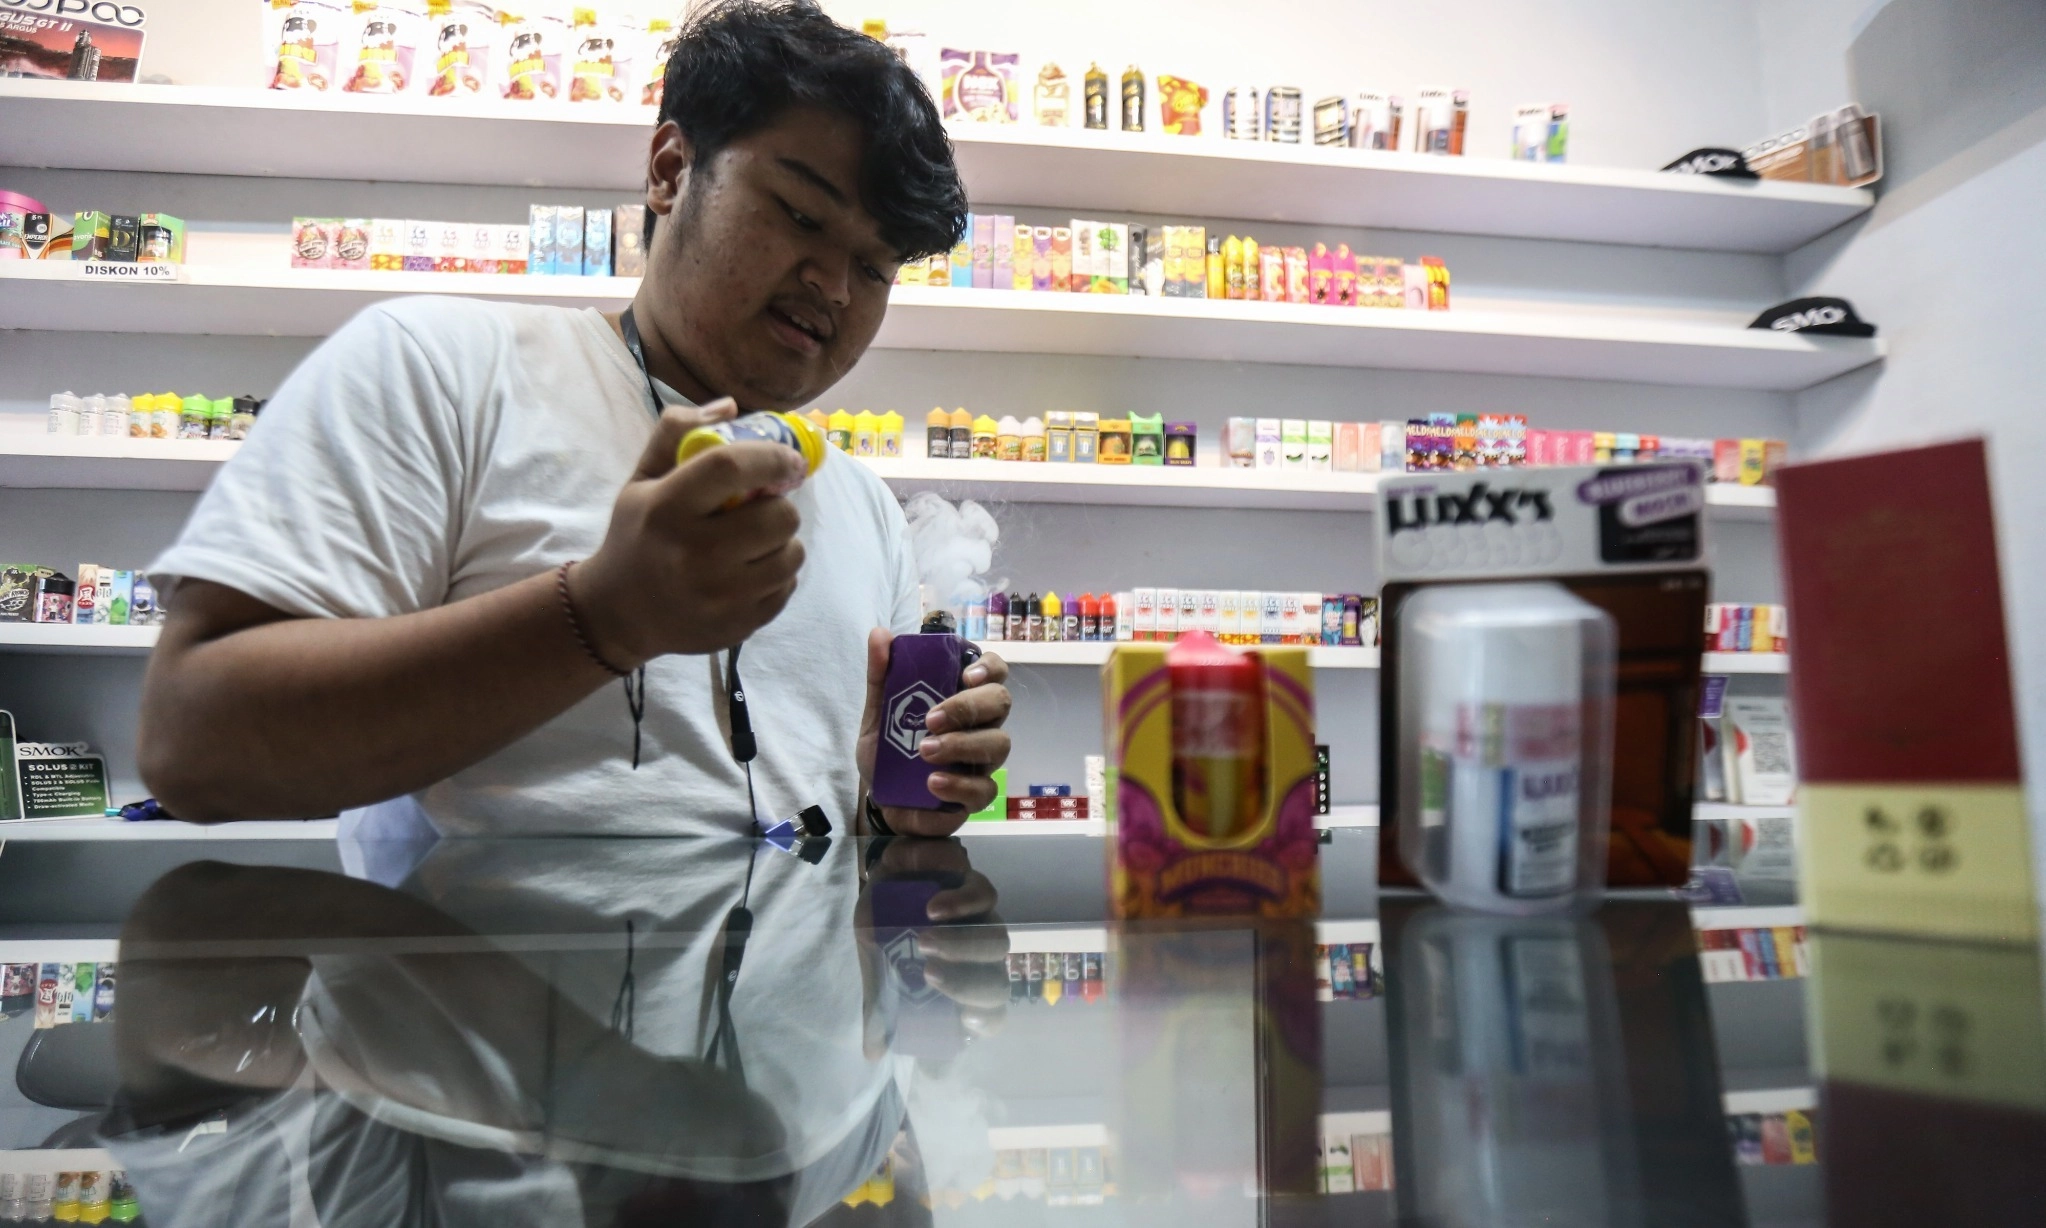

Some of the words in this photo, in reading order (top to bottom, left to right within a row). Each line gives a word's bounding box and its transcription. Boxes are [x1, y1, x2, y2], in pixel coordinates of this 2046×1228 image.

[85, 265, 139, 276] DISKON
[143, 265, 170, 276] 10%
[20, 746, 81, 757] SMOK
